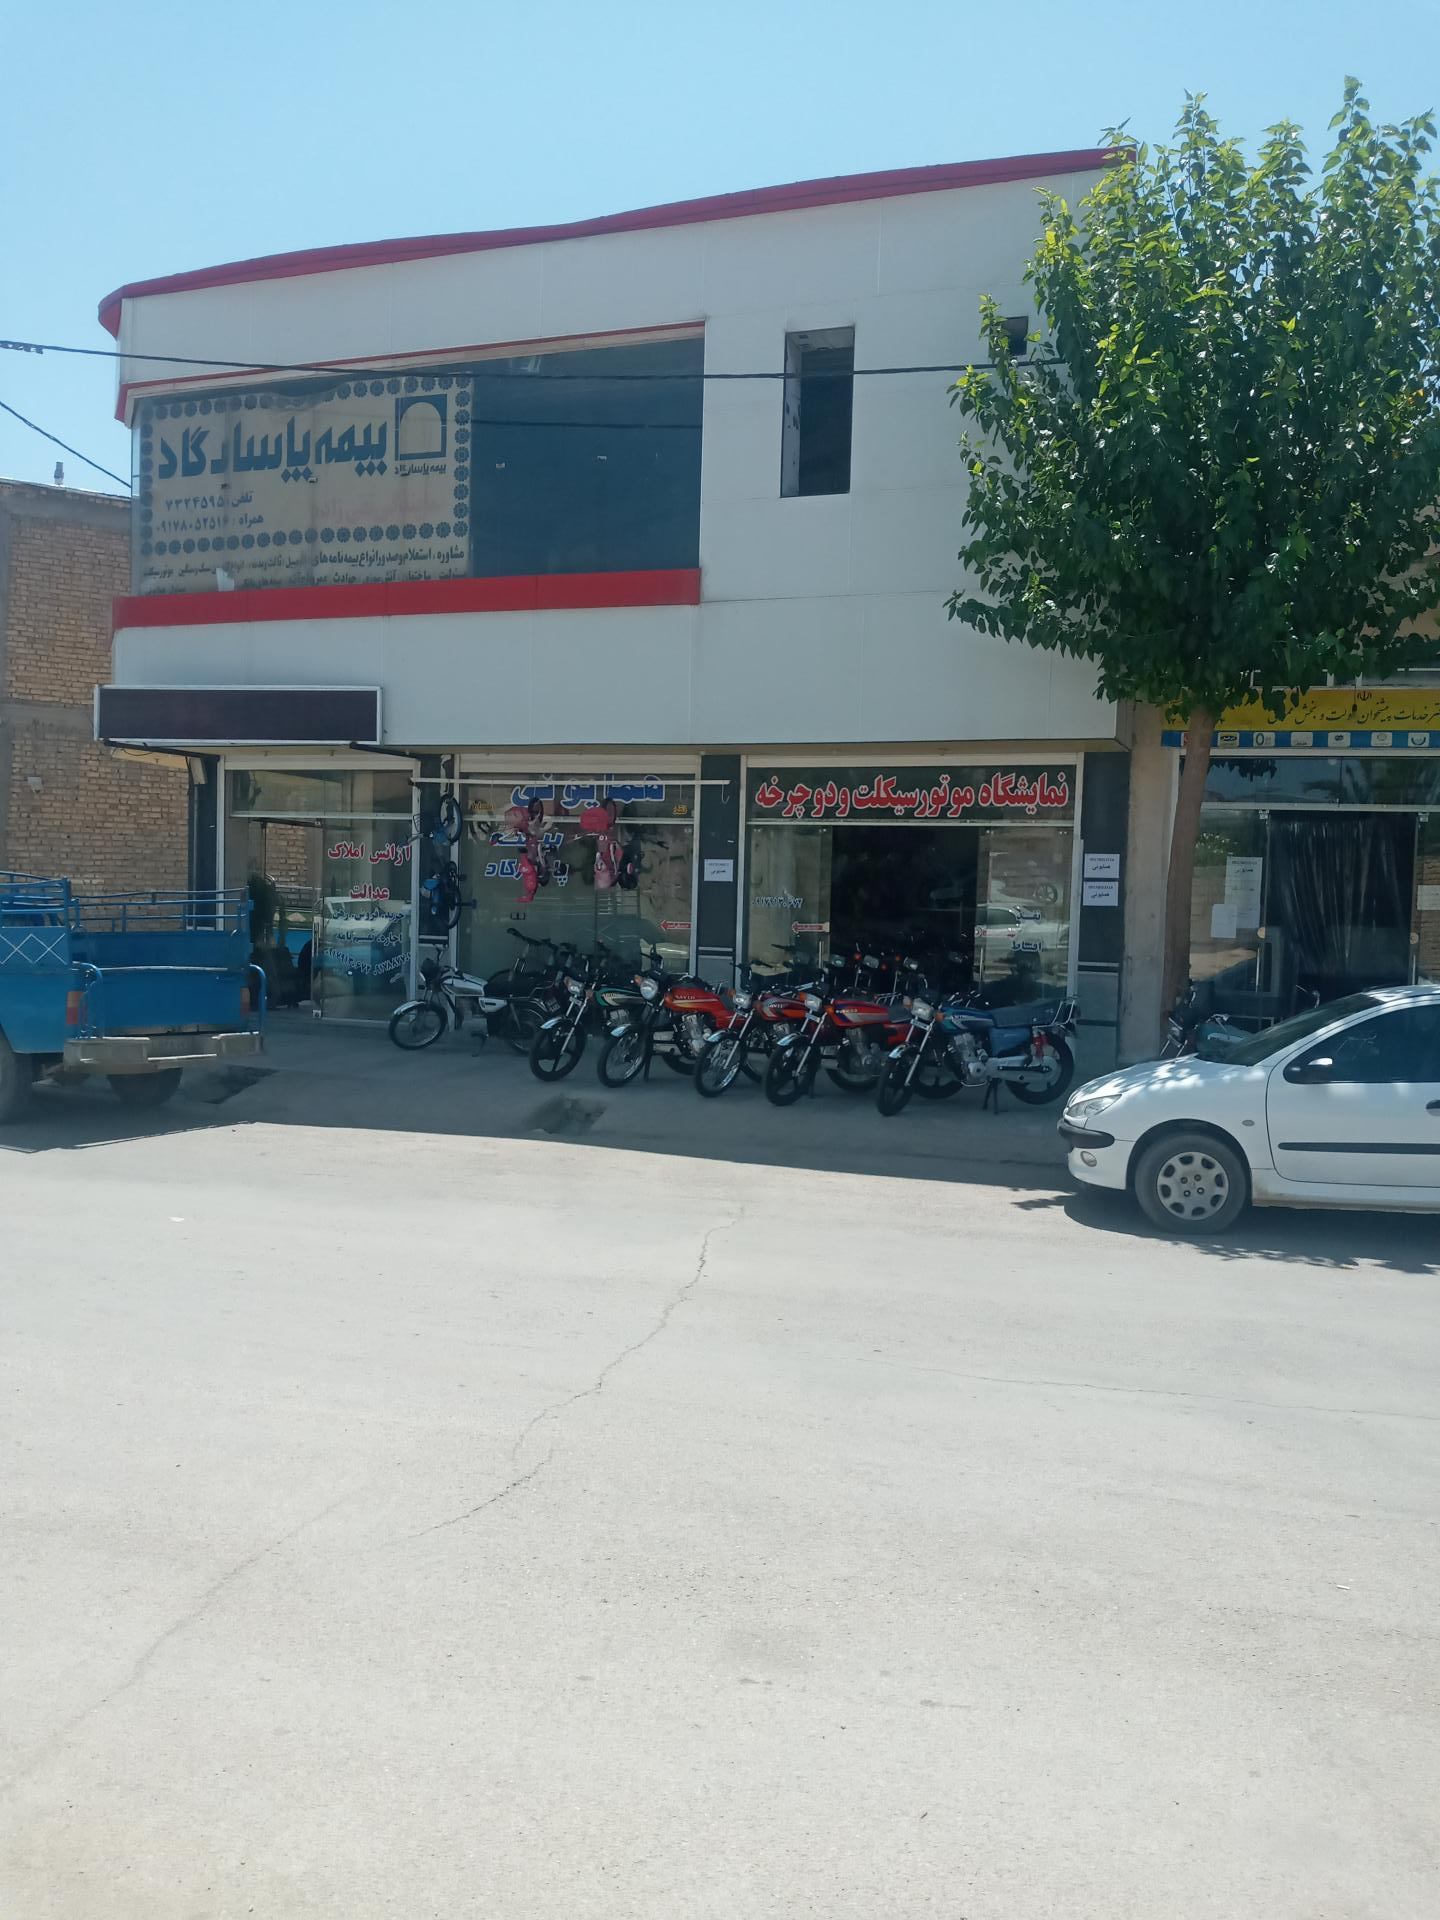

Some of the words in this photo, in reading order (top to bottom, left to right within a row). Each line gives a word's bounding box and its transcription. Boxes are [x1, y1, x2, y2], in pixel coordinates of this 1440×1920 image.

[158, 416, 312, 484] پاسارگاد
[315, 420, 387, 477] بیمه
[852, 774, 975, 818] موتورسیکلت
[978, 772, 1070, 815] نمایشگاه
[327, 841, 366, 859] املاک
[350, 883, 390, 900] عدالت
